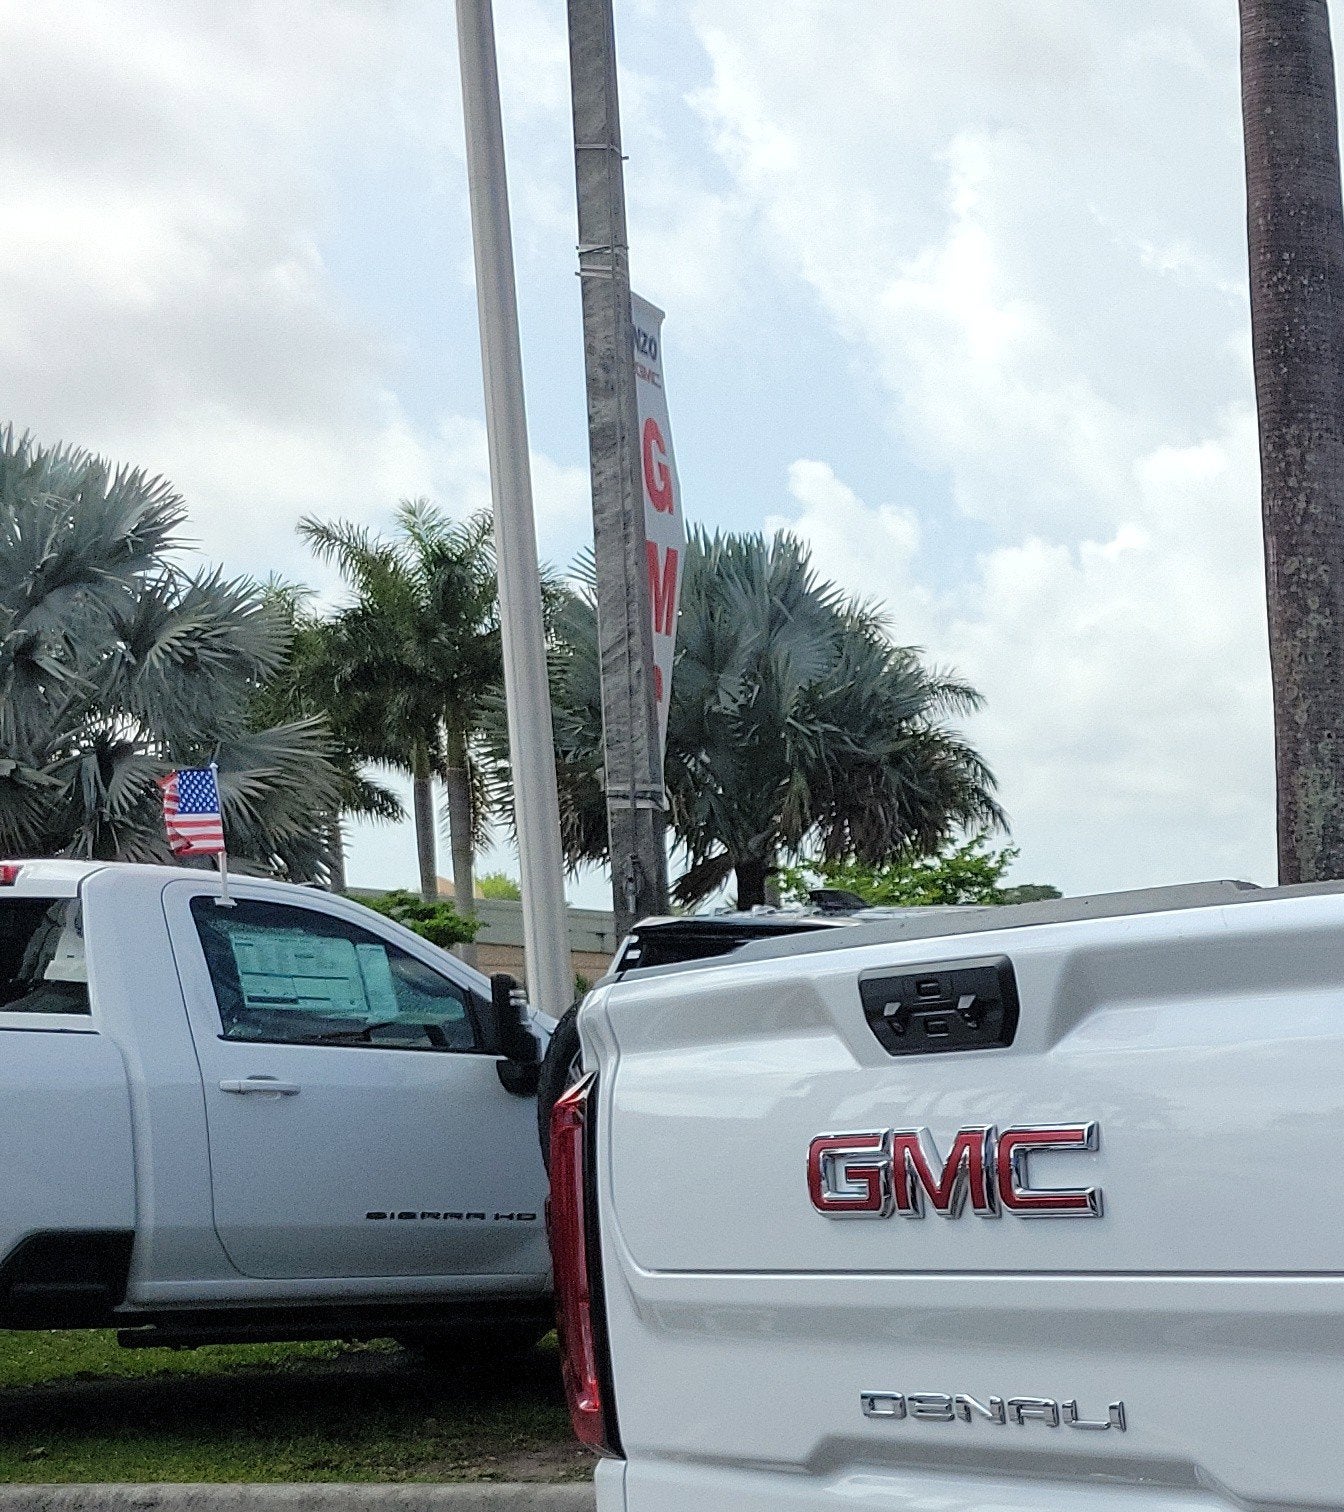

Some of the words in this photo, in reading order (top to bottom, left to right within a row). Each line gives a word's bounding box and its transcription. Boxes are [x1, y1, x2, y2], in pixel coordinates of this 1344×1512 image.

[807, 1121, 1103, 1219] GMC
[365, 1211, 486, 1221] SIERRA
[493, 1212, 537, 1221] HD
[860, 1390, 1127, 1432] DENALI
